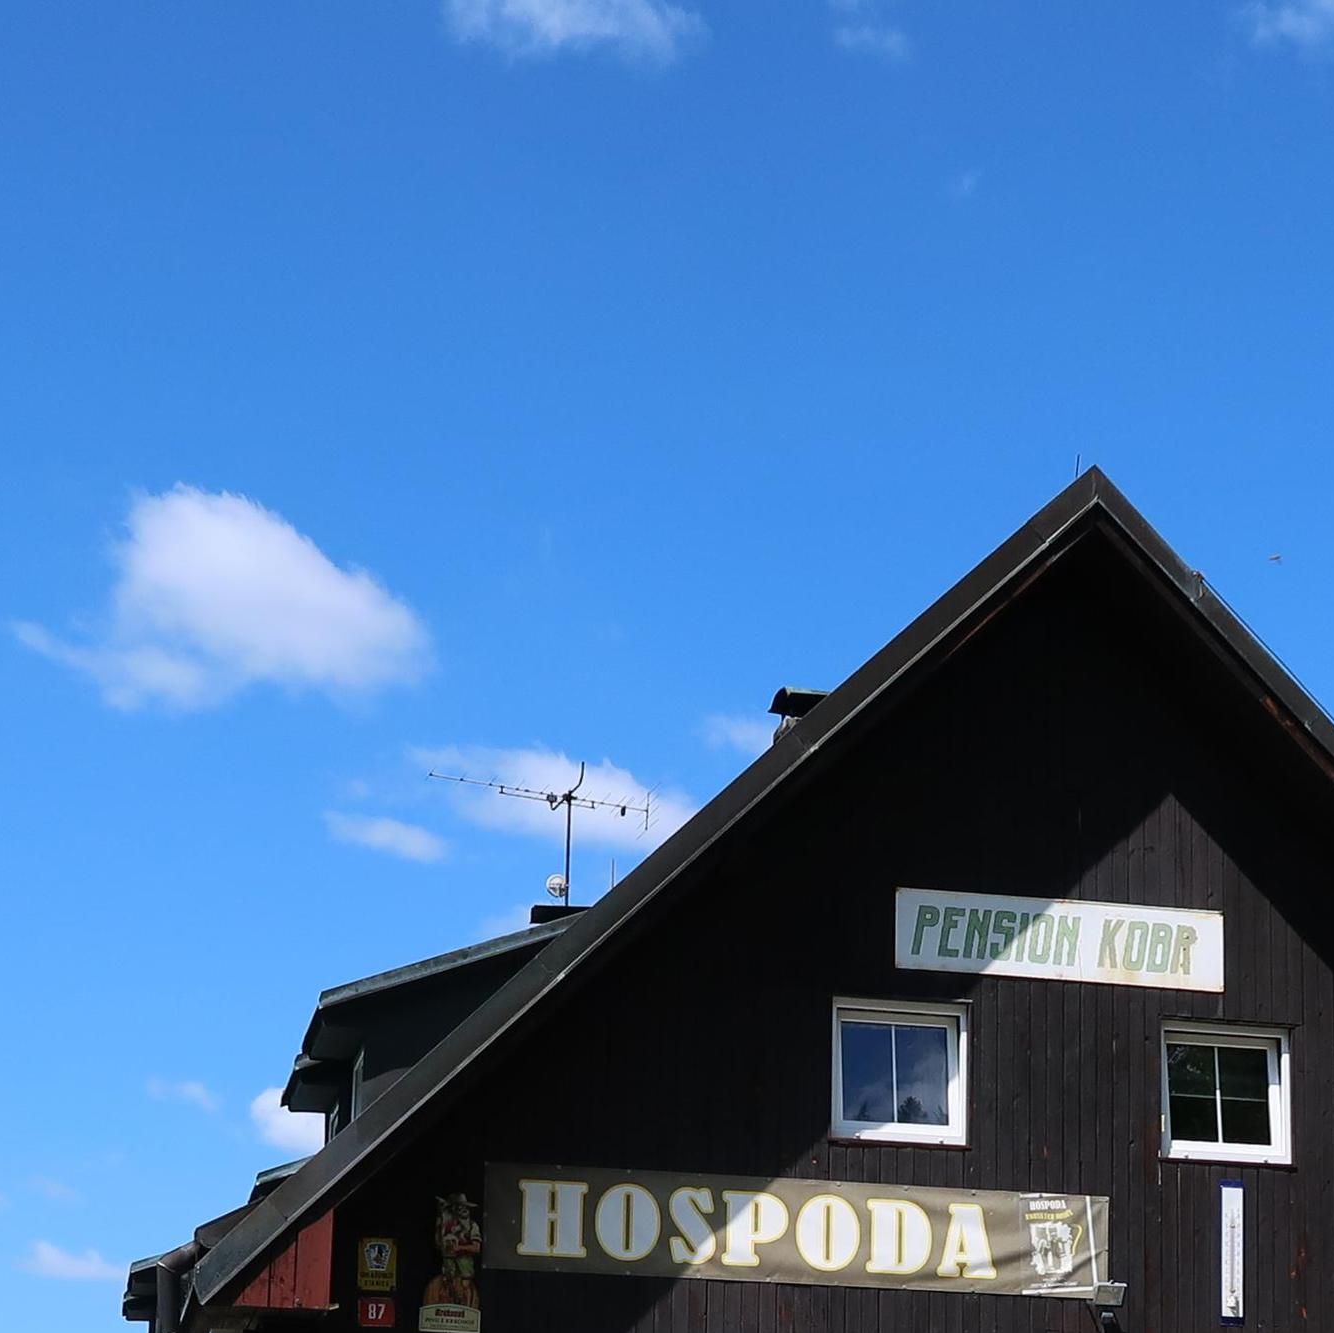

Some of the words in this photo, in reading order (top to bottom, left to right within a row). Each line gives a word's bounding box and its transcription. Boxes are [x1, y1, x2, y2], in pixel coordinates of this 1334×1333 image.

[910, 904, 1082, 967] PENSION
[1097, 918, 1198, 976] KOBR
[1029, 1199, 1067, 1211] HOSPODA
[516, 1177, 998, 1280] HOSPODA
[368, 1303, 386, 1320] 87
